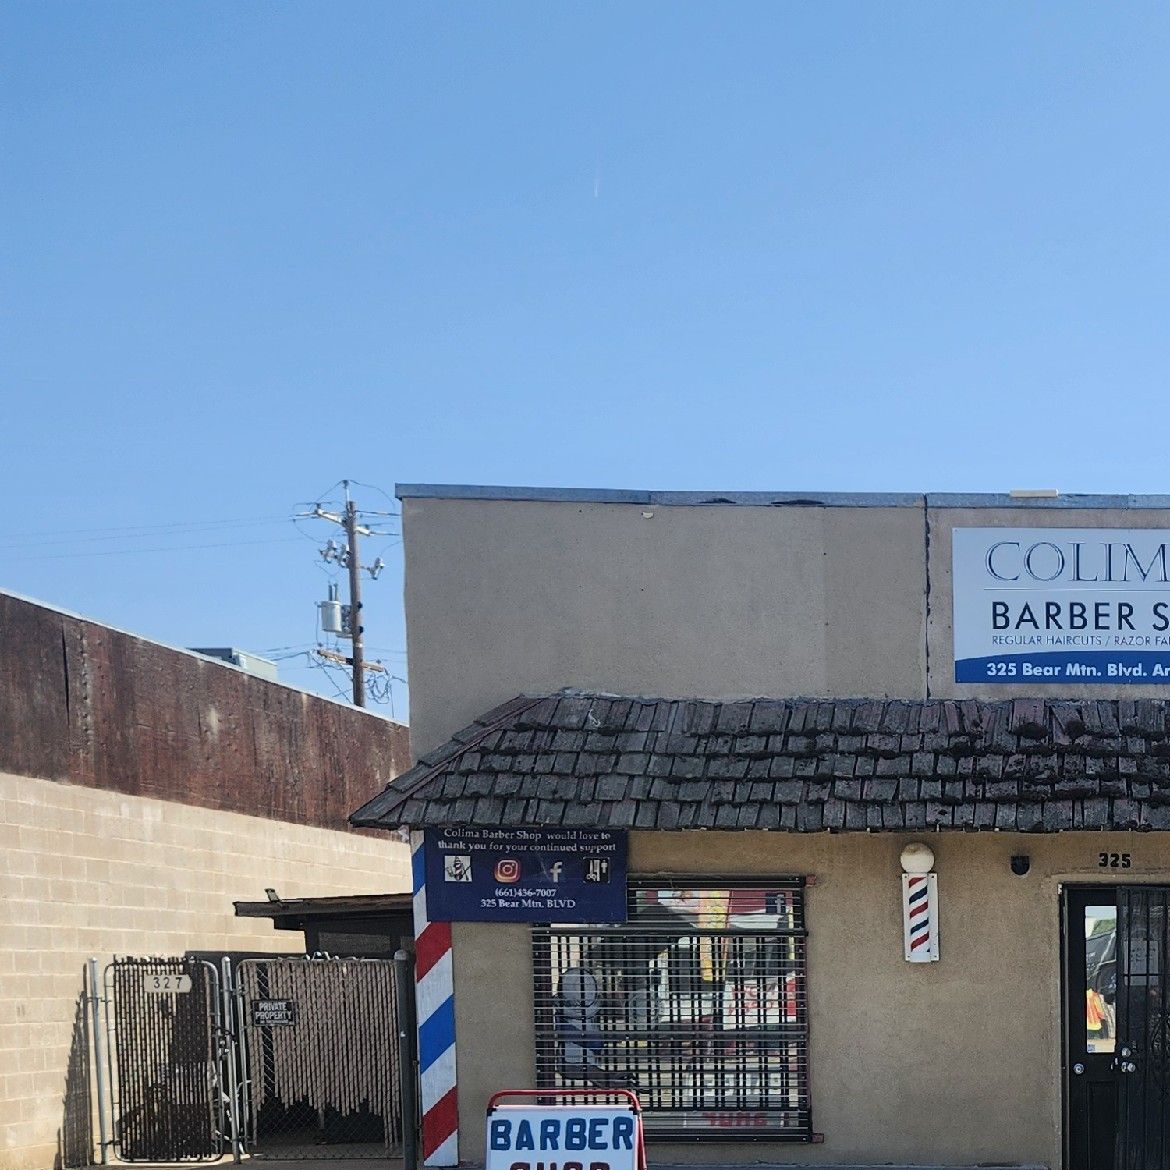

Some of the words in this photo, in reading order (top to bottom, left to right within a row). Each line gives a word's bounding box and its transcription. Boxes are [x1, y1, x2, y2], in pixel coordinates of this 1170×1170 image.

[992, 601, 1137, 631] BARBER
[992, 635, 1043, 646] REGULAR
[1046, 635, 1102, 646] HAIRCUTS
[1114, 635, 1151, 646] RAZOR
[987, 663, 1017, 677] 325
[1022, 663, 1062, 677] Bear
[1065, 663, 1102, 677] Mtn.
[1107, 663, 1148, 677] Blvd.
[444, 829, 480, 838] Colima
[482, 830, 515, 839] Barber
[516, 831, 542, 841] Shop
[547, 831, 577, 840] would
[579, 831, 599, 840] love
[601, 832, 611, 840] to
[438, 840, 466, 849] thank
[468, 843, 487, 852] you
[489, 842, 504, 850] for
[505, 843, 528, 853] your
[529, 842, 578, 852] continued
[580, 844, 616, 853] support
[1099, 852, 1131, 868] 325
[480, 899, 497, 908] 325
[498, 899, 520, 908] Bear
[522, 900, 545, 908] Mtn.
[547, 900, 576, 908] BLVD
[153, 976, 183, 989] 327
[258, 1002, 287, 1011] PRIVATE
[255, 1011, 292, 1020] PROPERTY
[491, 1117, 633, 1151] BARBER
